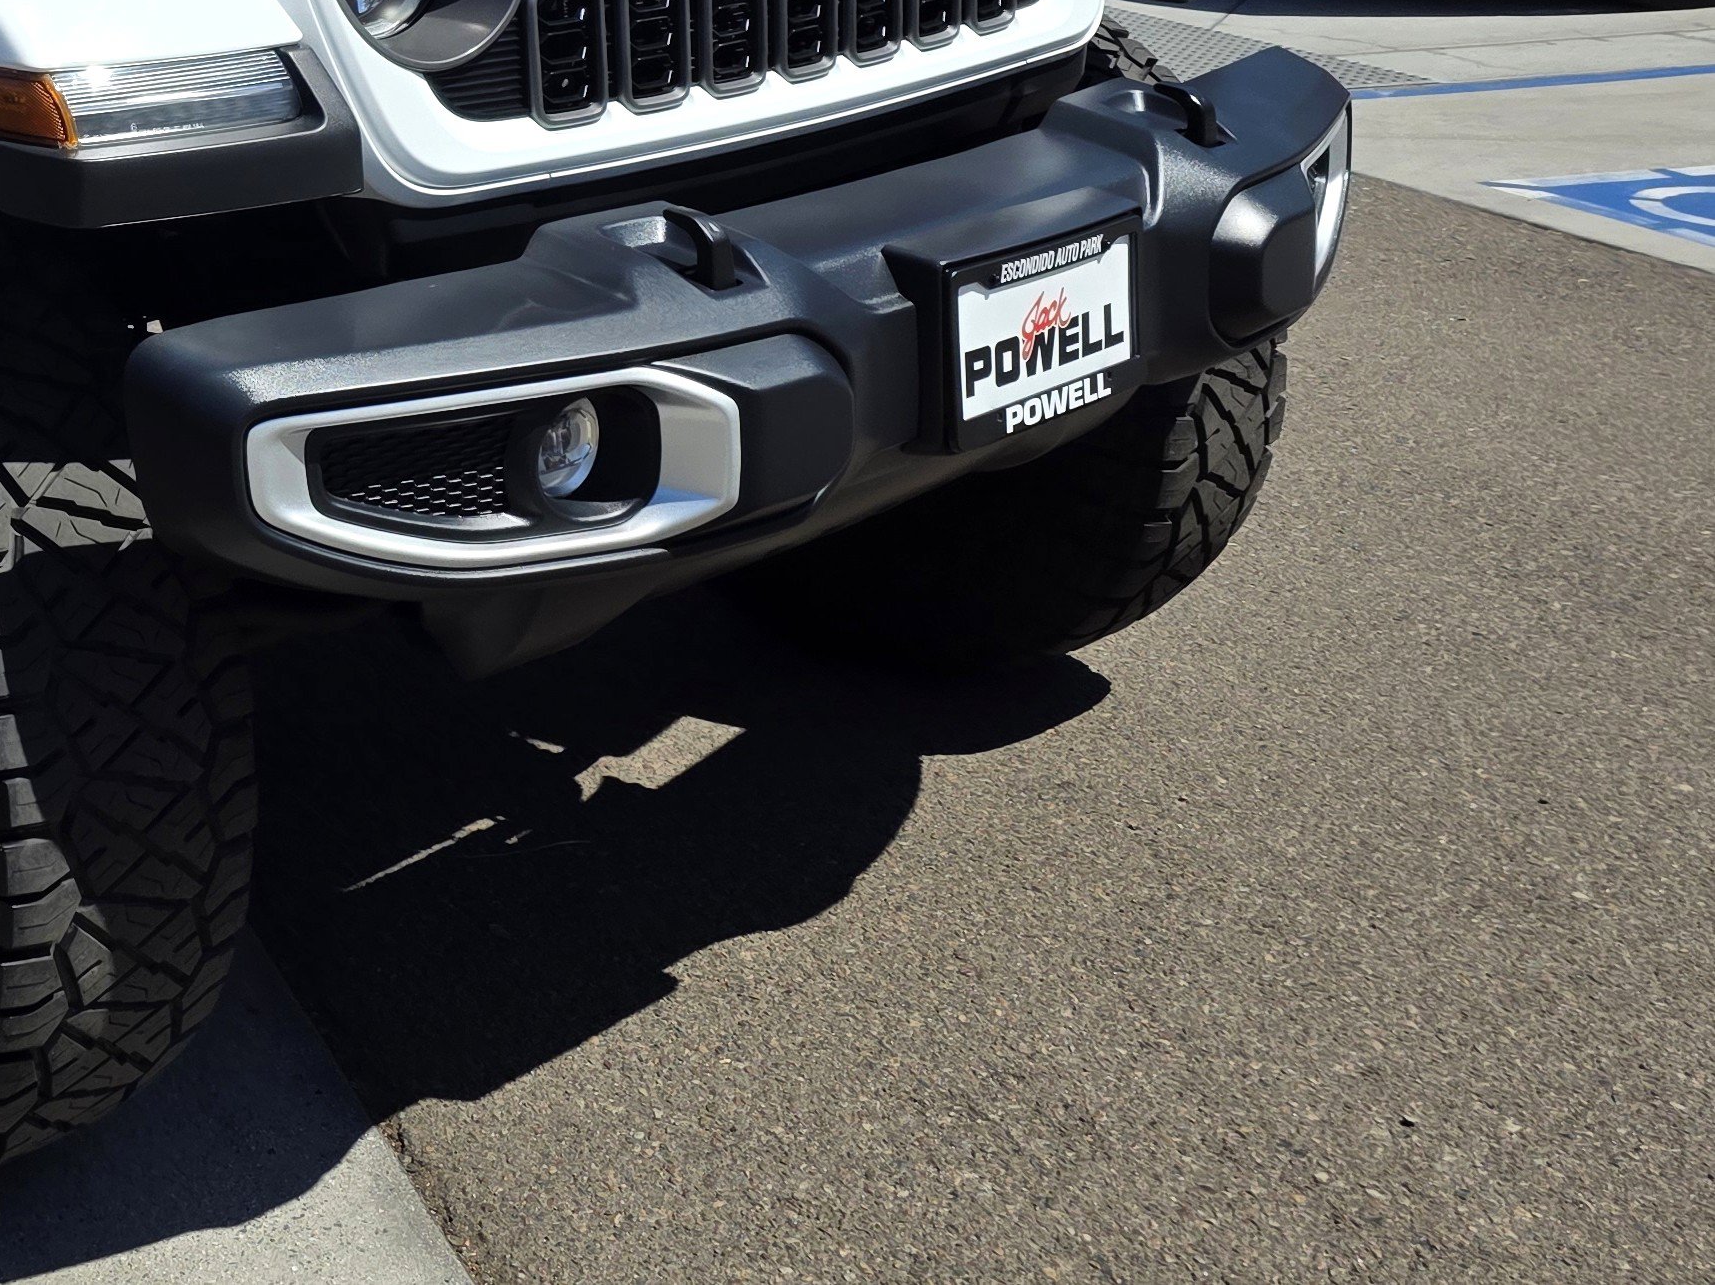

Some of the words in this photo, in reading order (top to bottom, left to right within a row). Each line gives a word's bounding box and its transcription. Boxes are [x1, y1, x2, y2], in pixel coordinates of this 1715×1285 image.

[1000, 255, 1055, 284] ESCONDIDO
[1055, 244, 1079, 267] AUTO
[1079, 233, 1105, 259] PARK
[964, 303, 1125, 399] POWELL
[1021, 286, 1072, 361] Jack
[1005, 373, 1112, 434] POWELL
